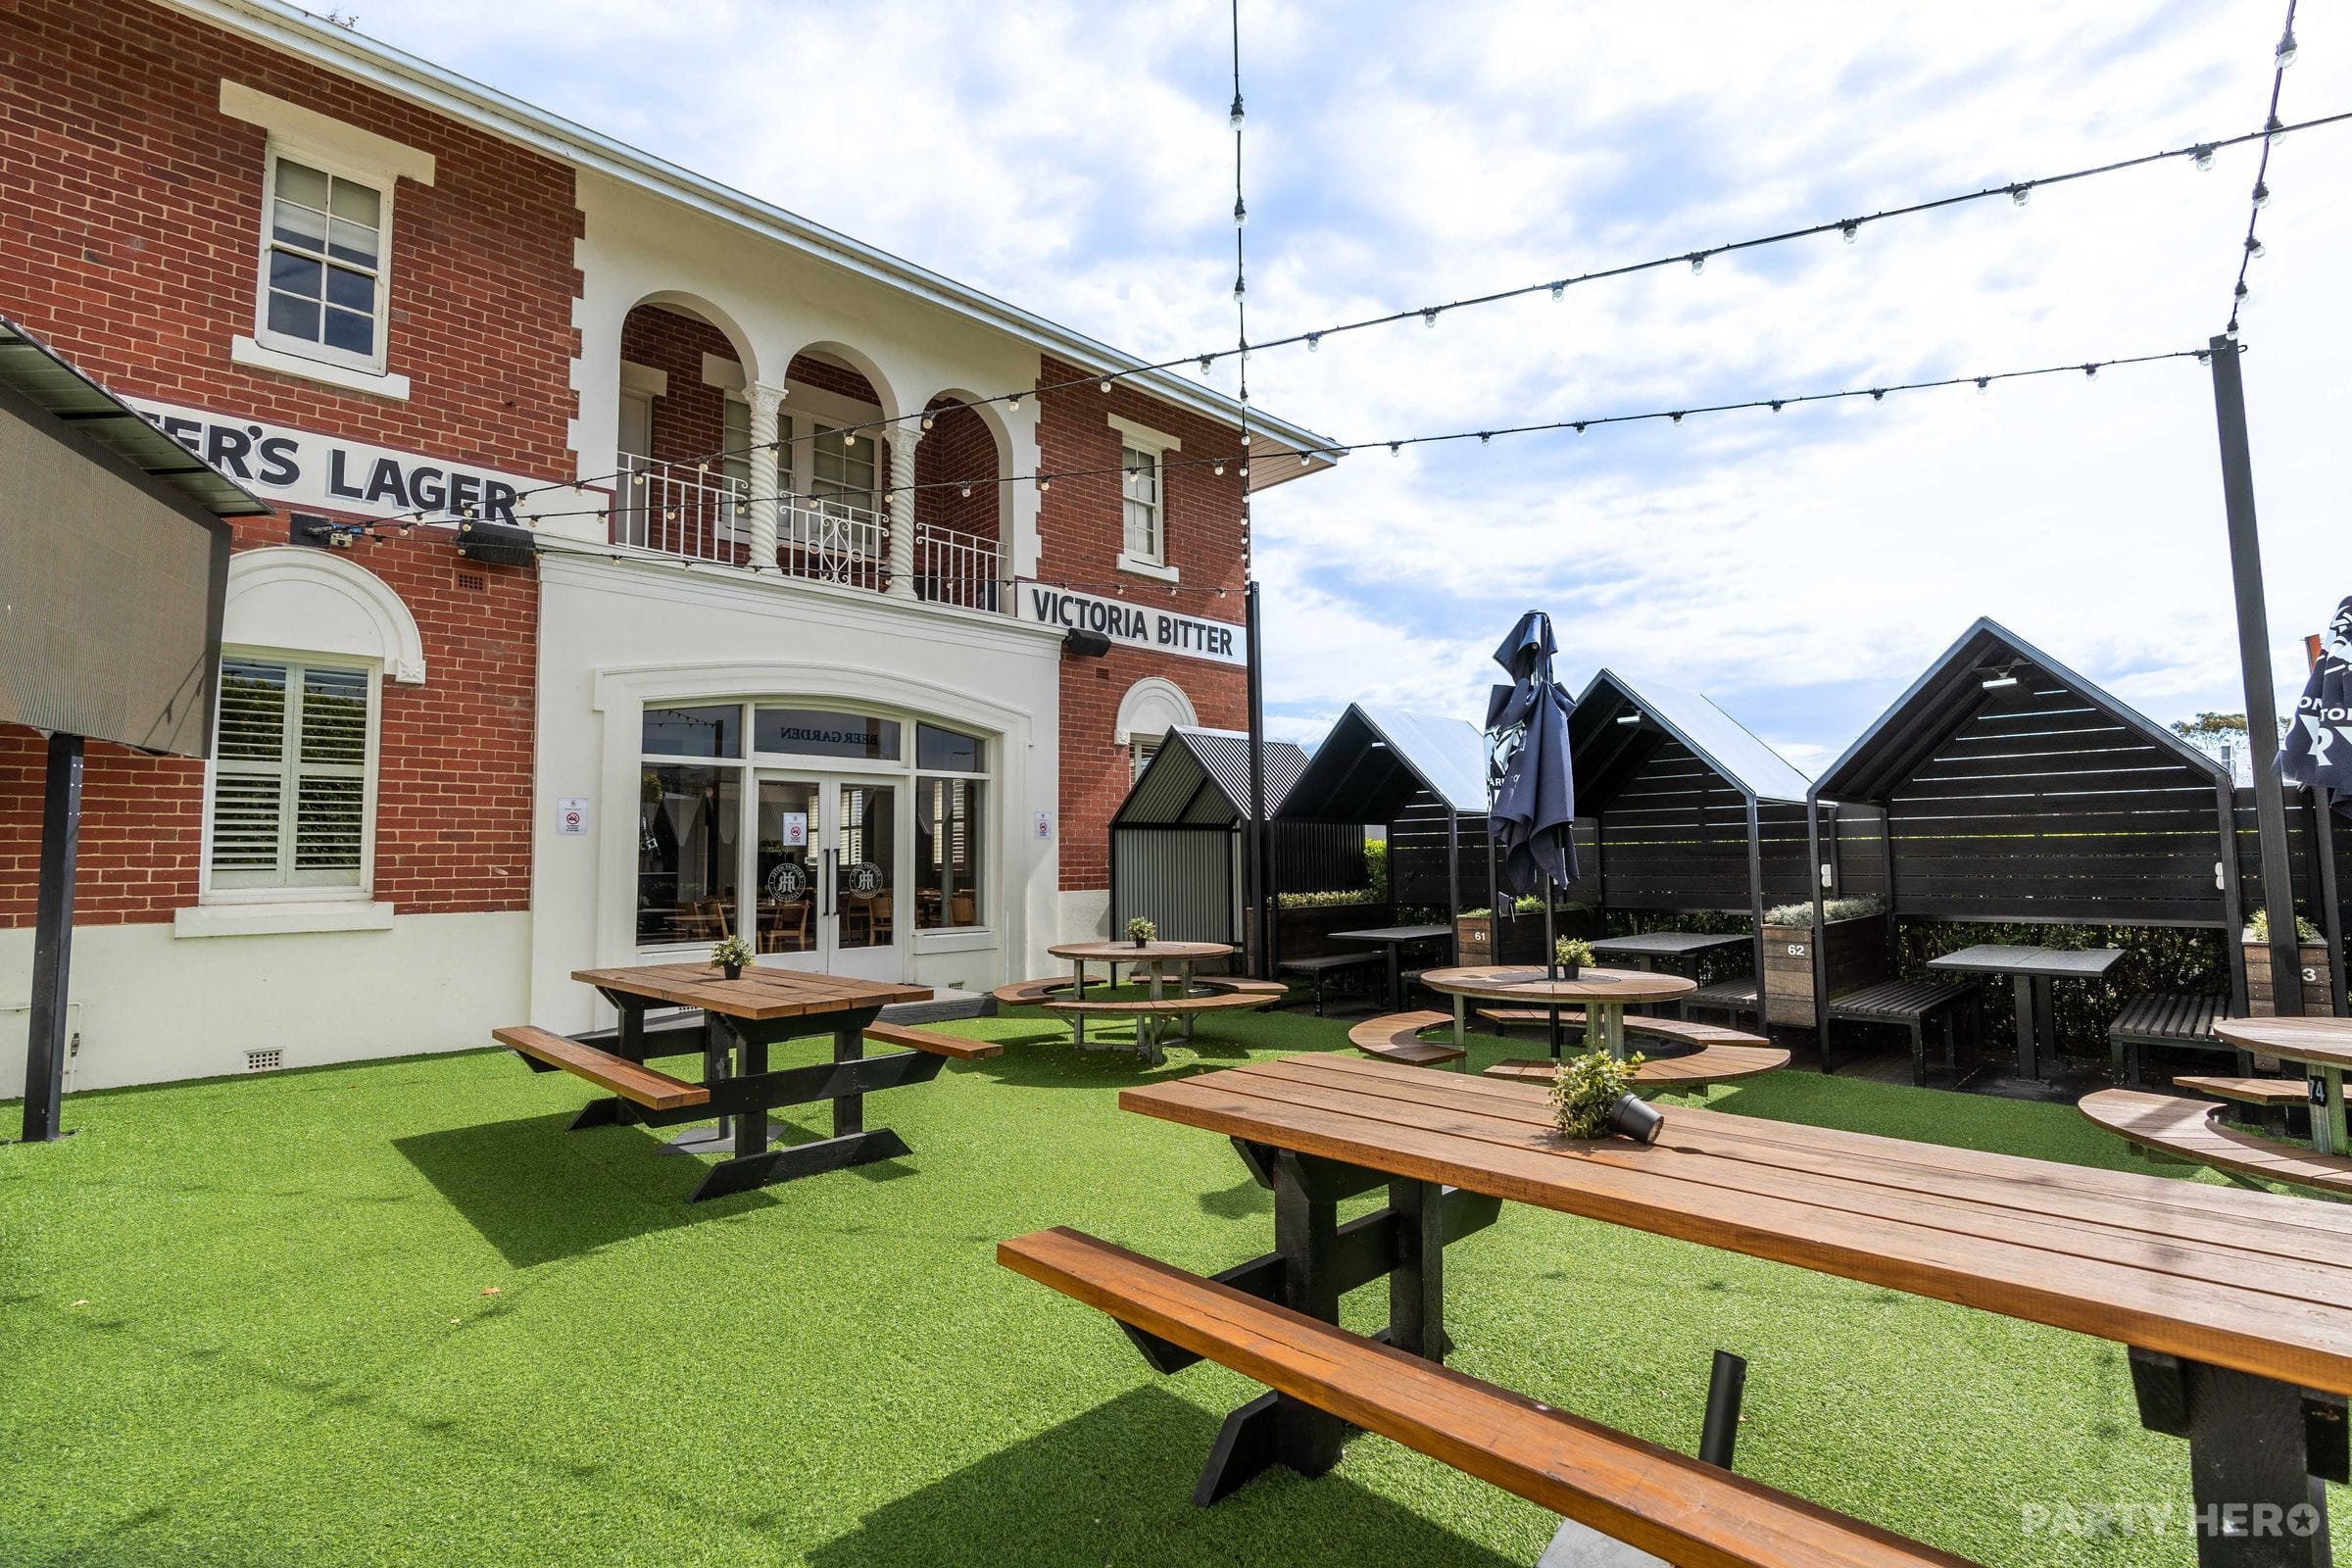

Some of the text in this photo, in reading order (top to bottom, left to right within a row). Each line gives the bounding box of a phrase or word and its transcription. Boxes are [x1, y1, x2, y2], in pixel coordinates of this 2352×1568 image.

[140, 411, 519, 526] ER'S LAGER
[1032, 588, 1233, 657] VICTORIA BITTER
[1475, 932, 1486, 941] 61
[1788, 945, 1804, 956] 62
